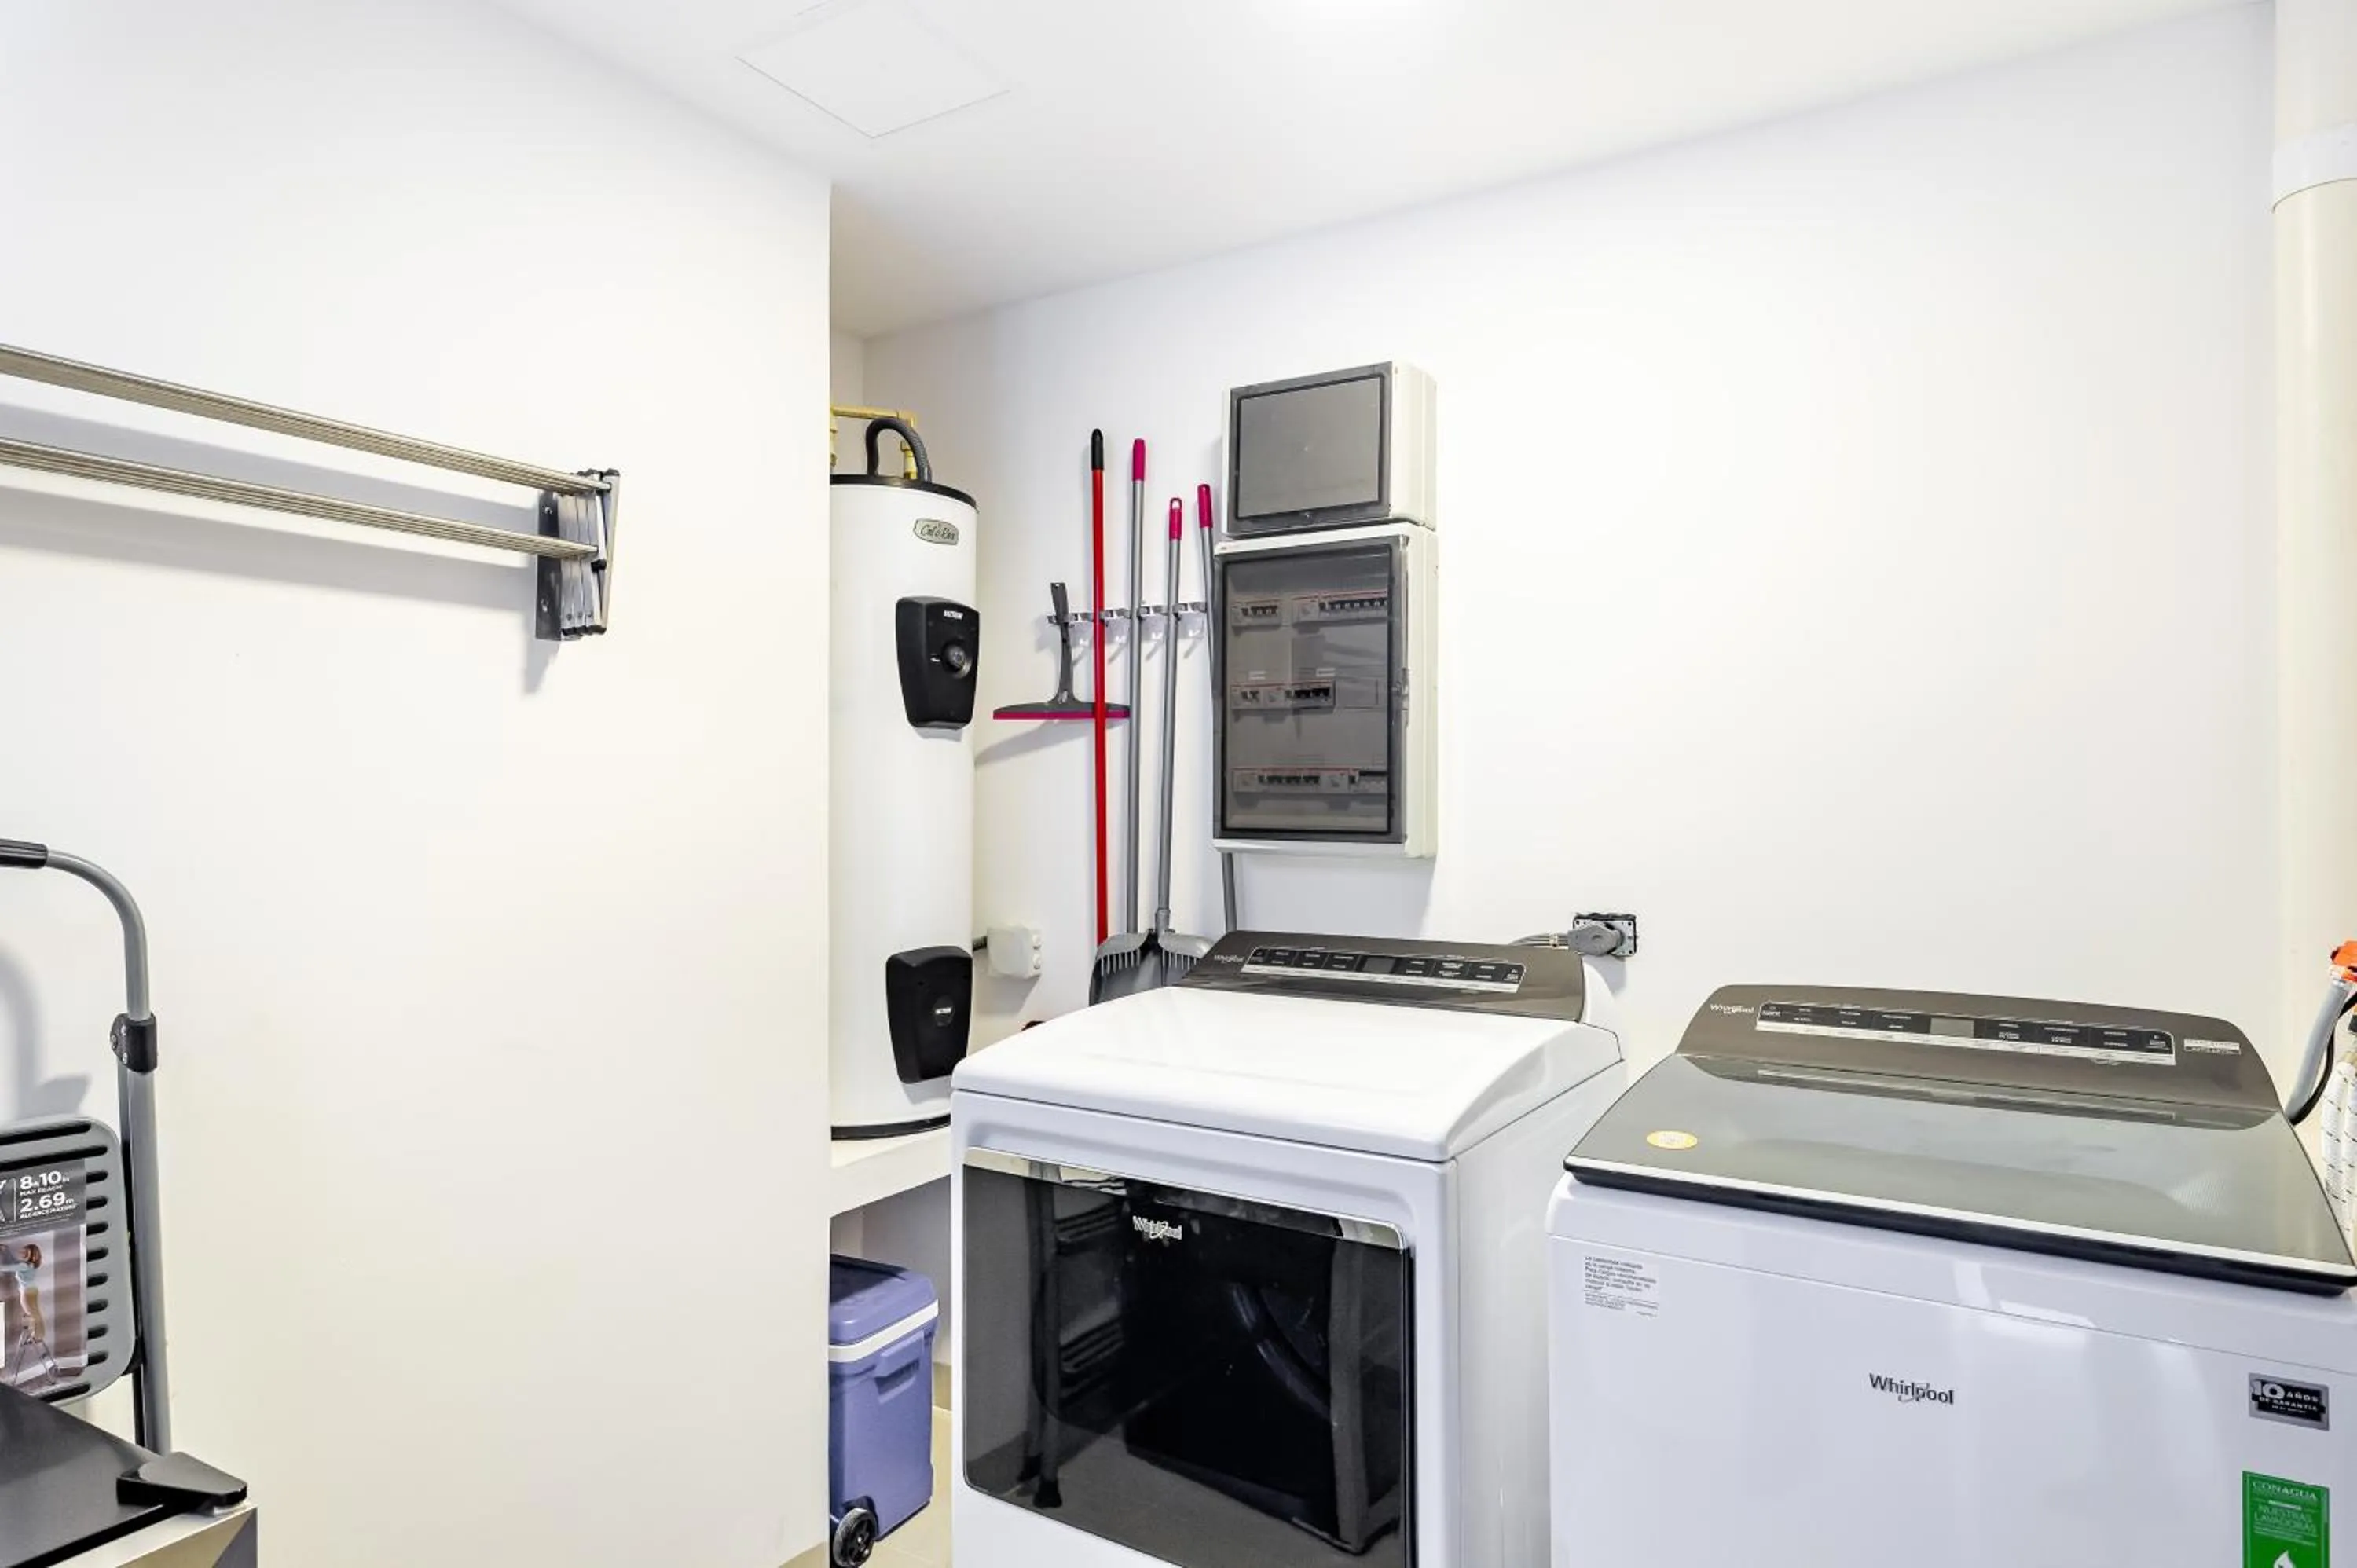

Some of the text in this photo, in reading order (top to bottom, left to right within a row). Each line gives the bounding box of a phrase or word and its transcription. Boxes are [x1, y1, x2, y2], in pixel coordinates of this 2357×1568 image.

[1132, 1215, 1182, 1240] Whirlpool
[1869, 1372, 1954, 1405] Whirlpool
[2251, 1380, 2285, 1399] 10
[2253, 1482, 2317, 1500] CONAGUA
